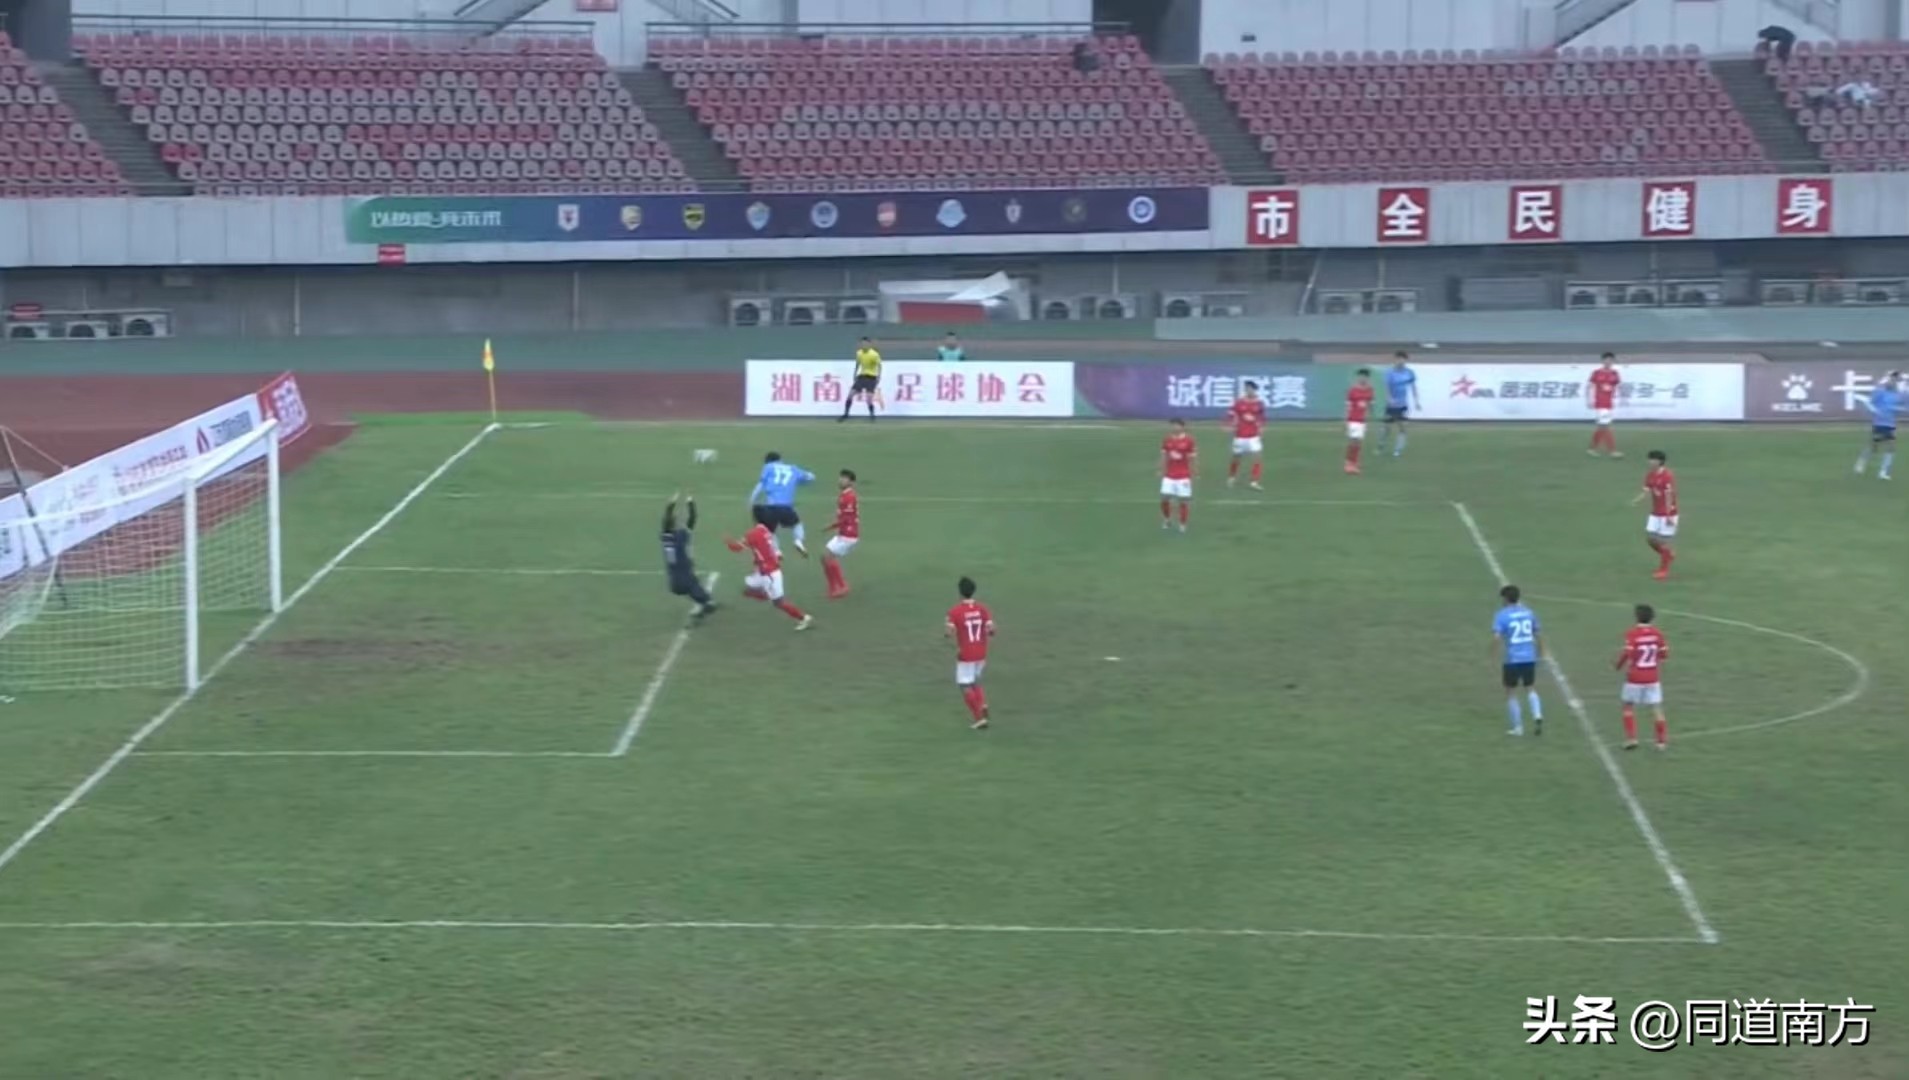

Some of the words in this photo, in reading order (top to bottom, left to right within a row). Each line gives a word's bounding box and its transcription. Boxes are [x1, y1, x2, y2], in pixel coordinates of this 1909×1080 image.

[1252, 184, 1826, 239] 市全民健身
[1166, 375, 1307, 408] 诚信联赛
[965, 619, 983, 643] 17
[1509, 619, 1533, 644] 29
